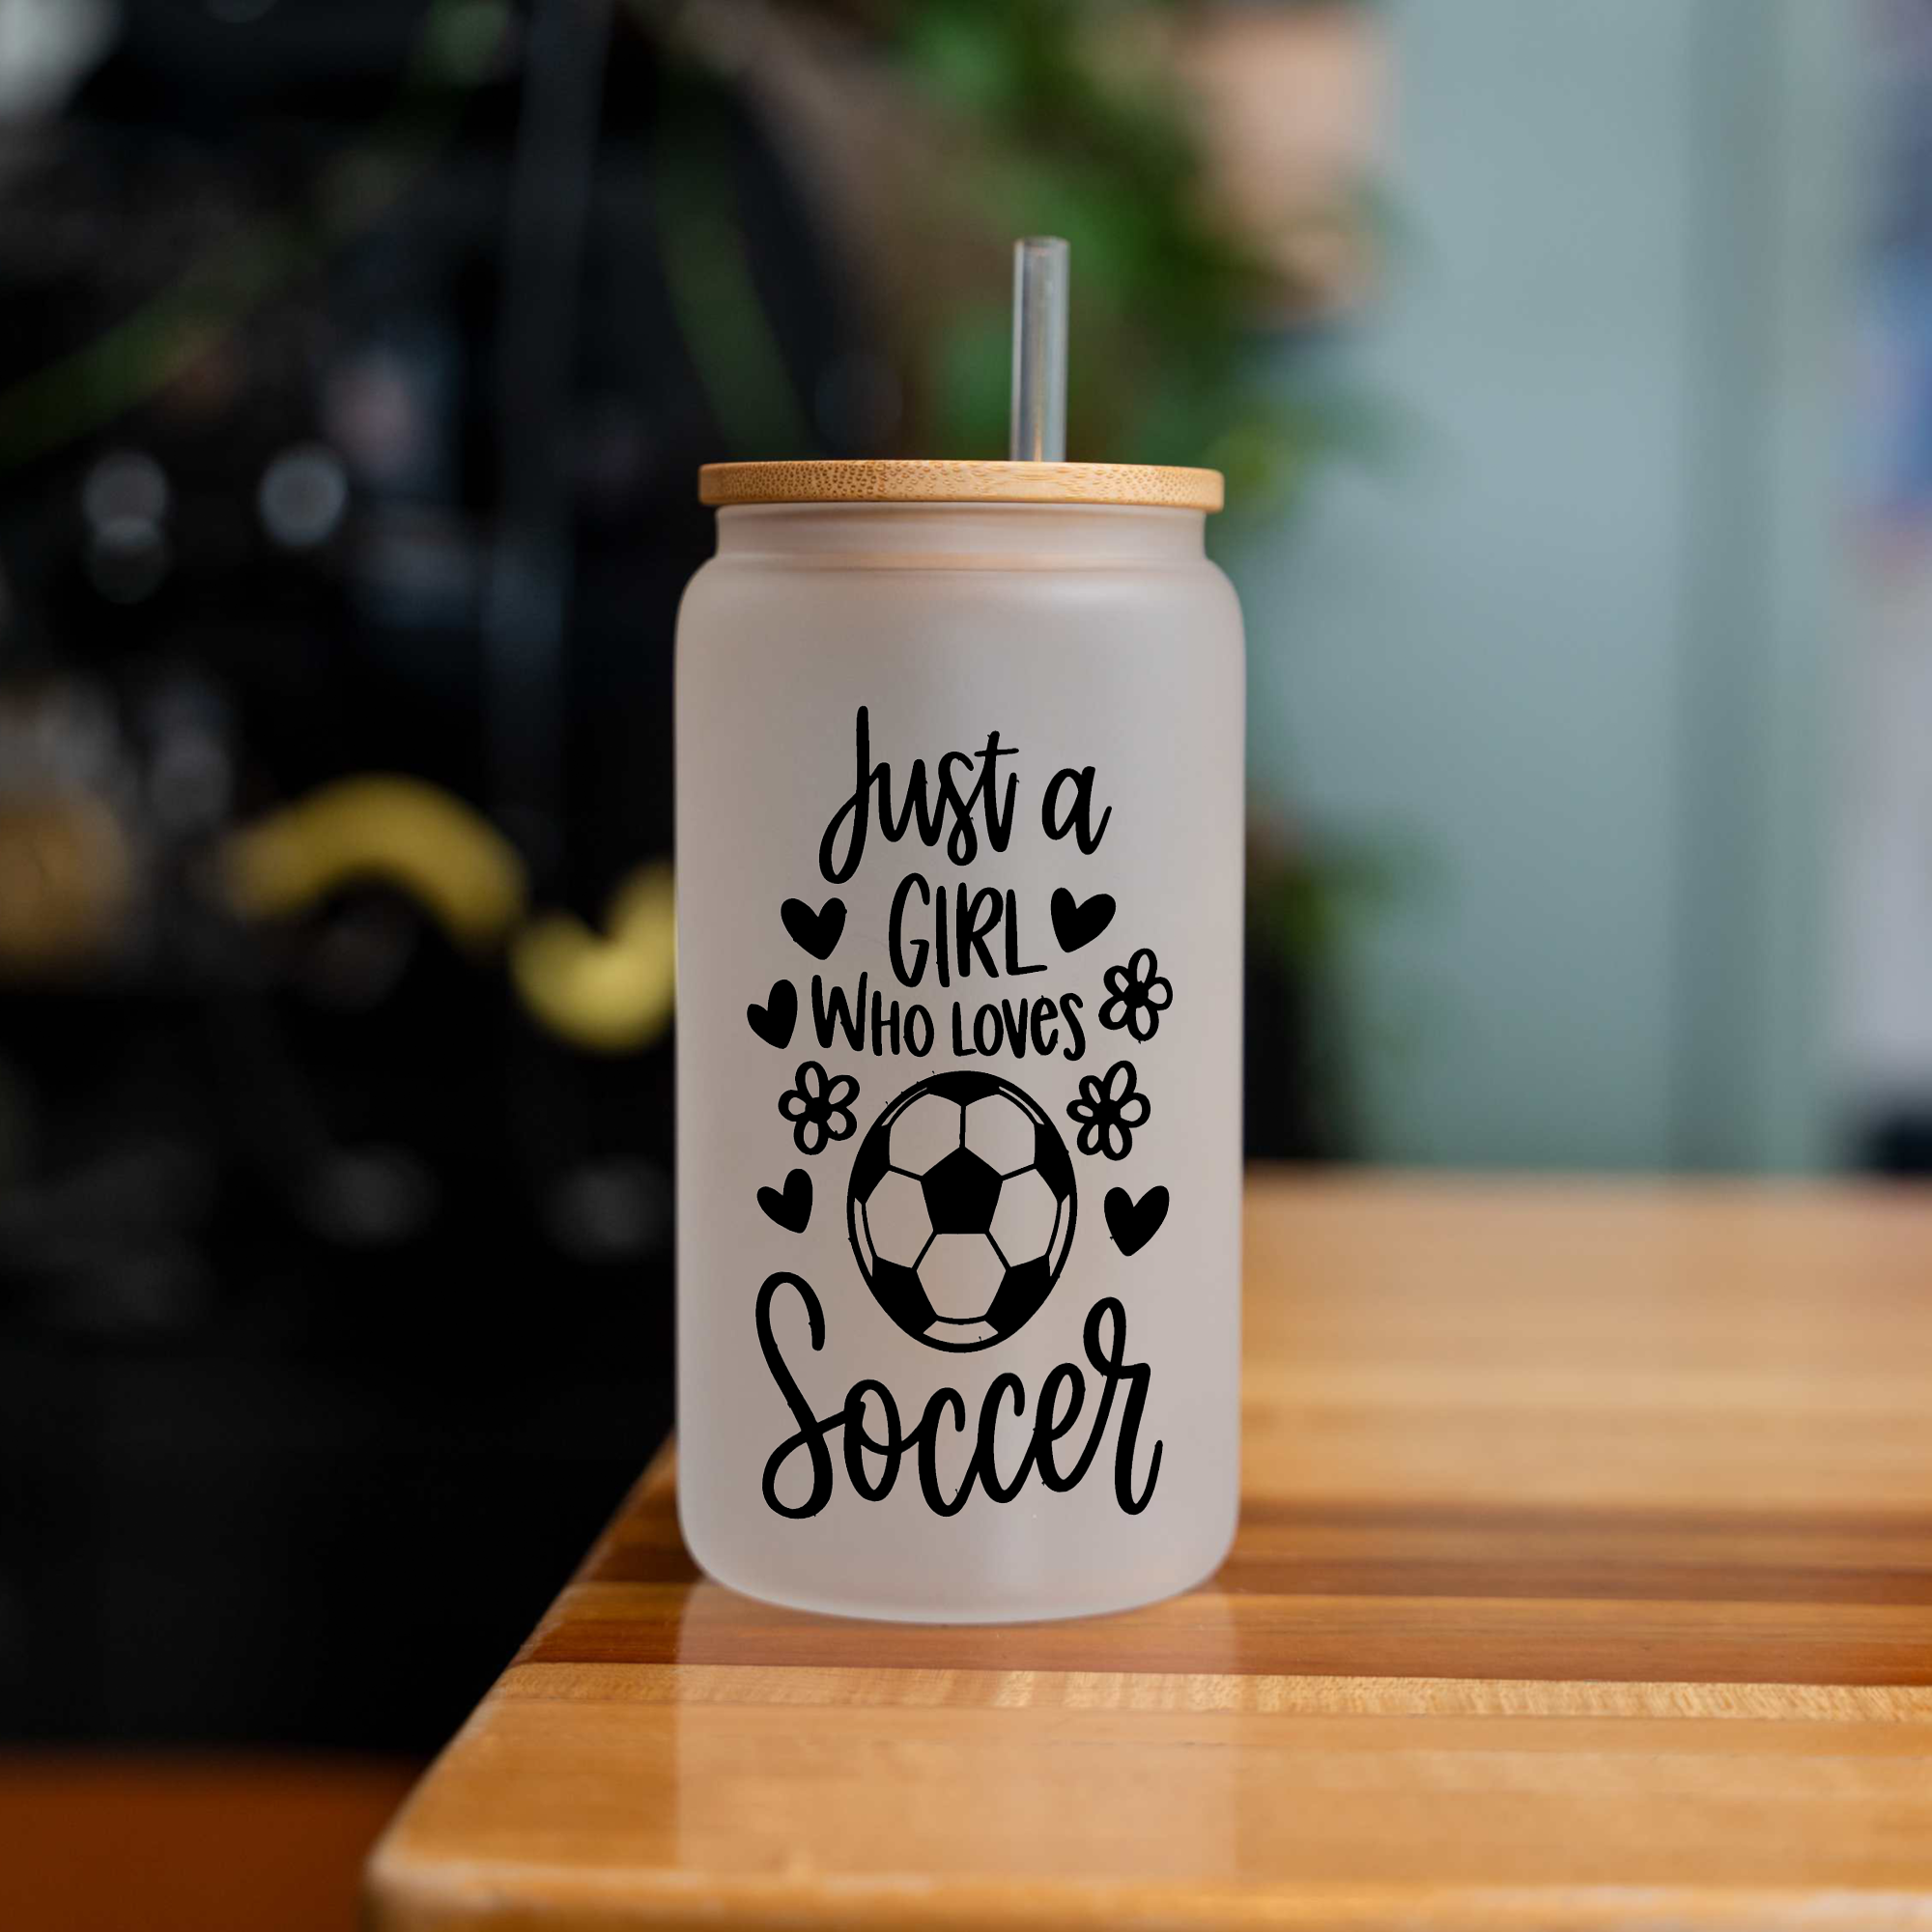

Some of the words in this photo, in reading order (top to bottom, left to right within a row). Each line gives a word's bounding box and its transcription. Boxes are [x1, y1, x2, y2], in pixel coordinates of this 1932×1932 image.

[819, 705, 1019, 884] Just
[1041, 765, 1113, 856] a
[888, 871, 1048, 988] GIRL
[810, 971, 935, 1059] WHO
[755, 1270, 1164, 1520] Soccer
